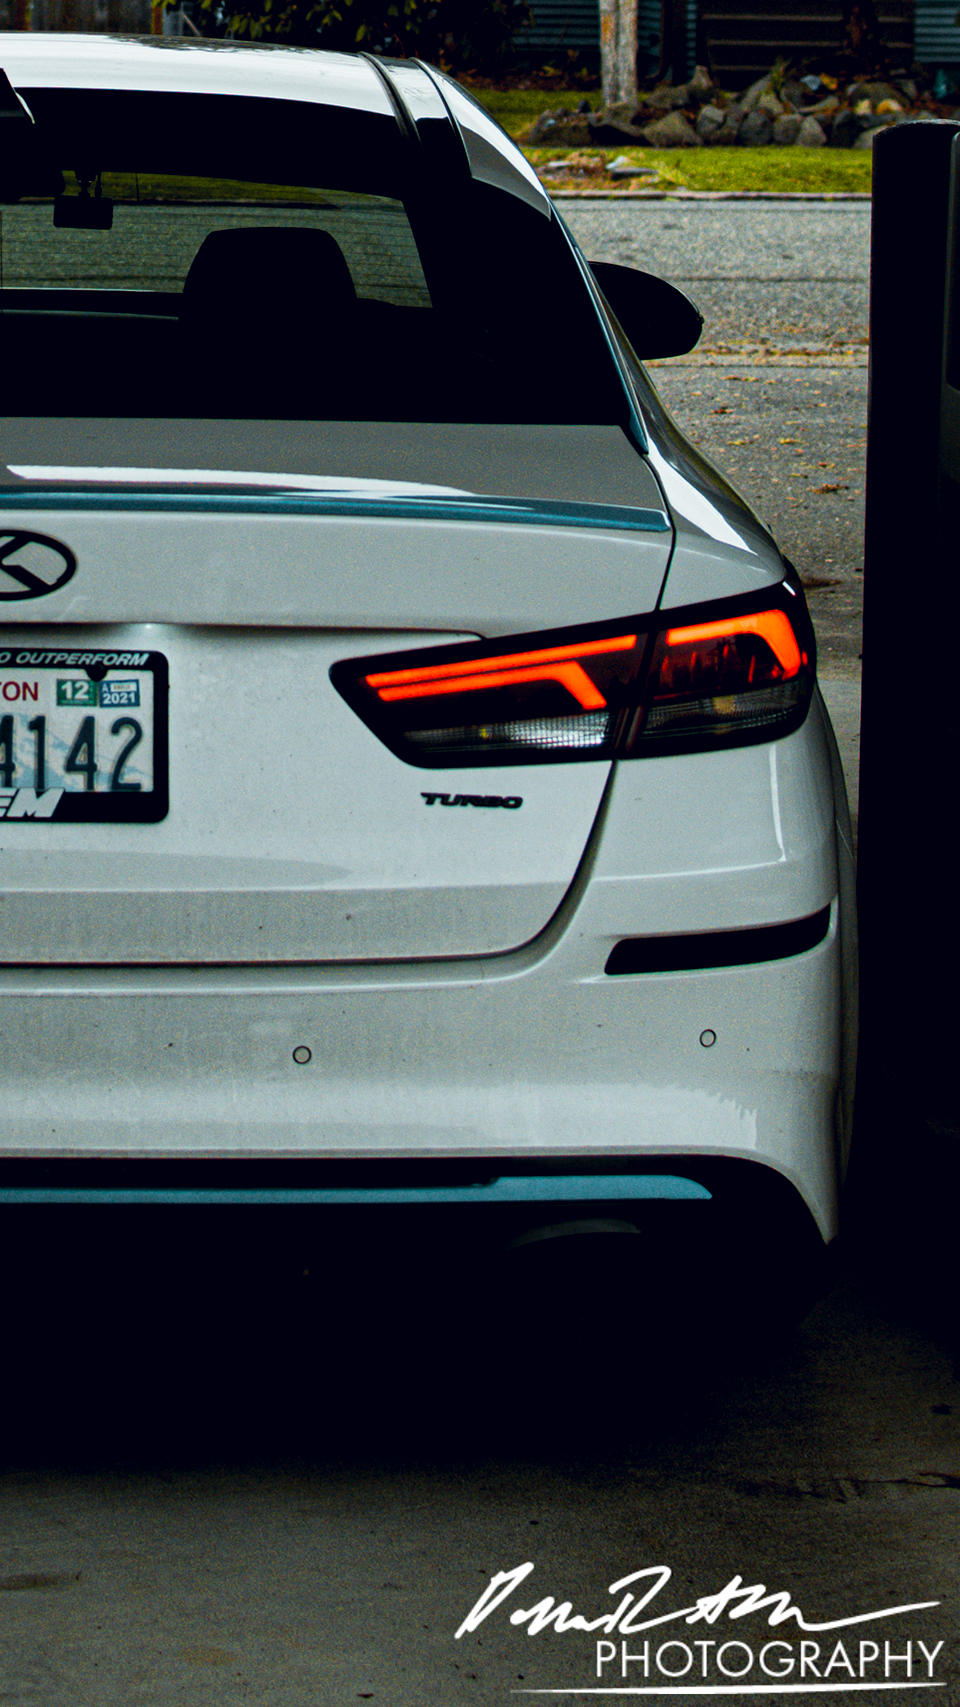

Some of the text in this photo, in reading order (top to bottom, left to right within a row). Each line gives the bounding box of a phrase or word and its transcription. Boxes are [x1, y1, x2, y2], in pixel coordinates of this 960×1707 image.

[15, 651, 150, 666] OUTPERFORM
[61, 680, 90, 701] 12
[102, 691, 136, 705] 2021
[420, 792, 523, 809] TURBO
